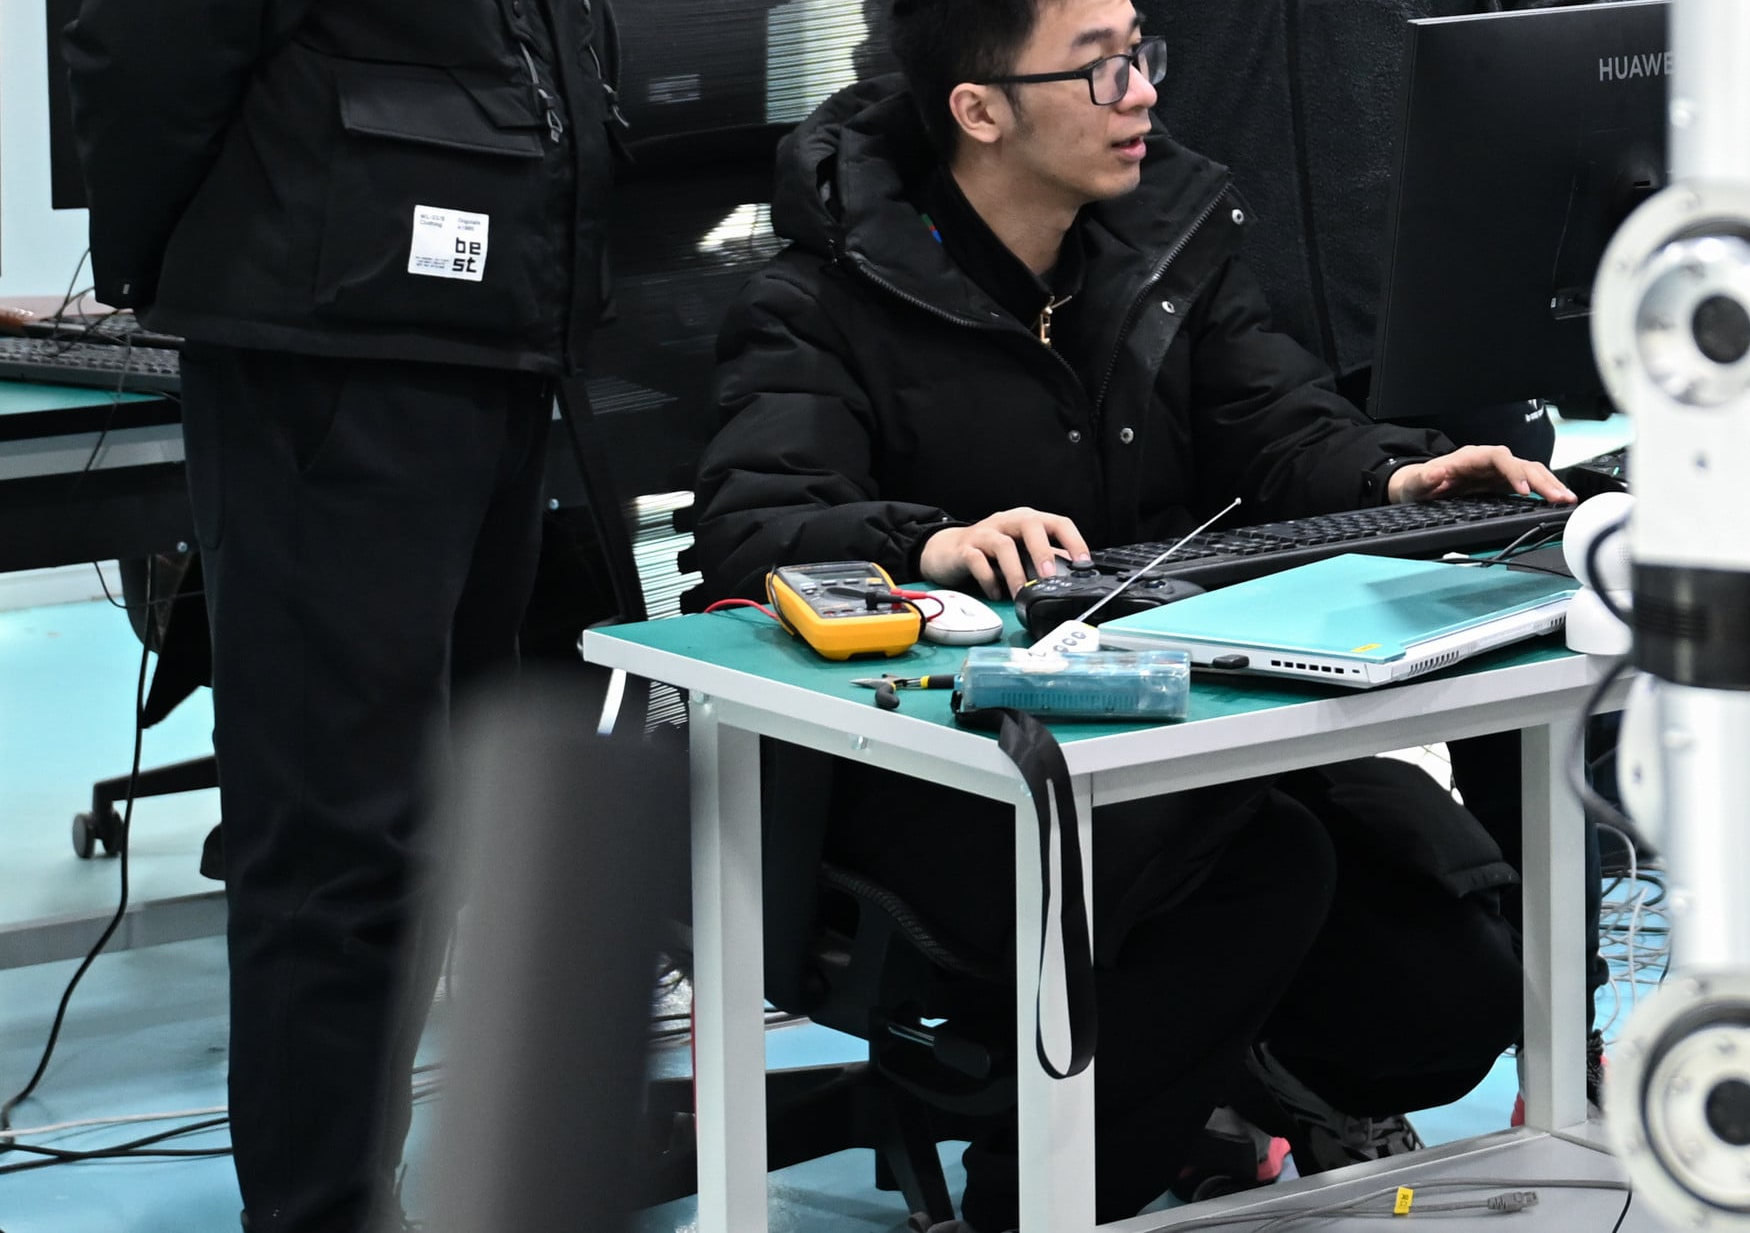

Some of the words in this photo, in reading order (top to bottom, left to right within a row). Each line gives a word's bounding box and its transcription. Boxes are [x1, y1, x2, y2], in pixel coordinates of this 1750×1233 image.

[1599, 52, 1676, 82] HUAWE
[455, 237, 481, 255] be
[452, 257, 477, 273] st
